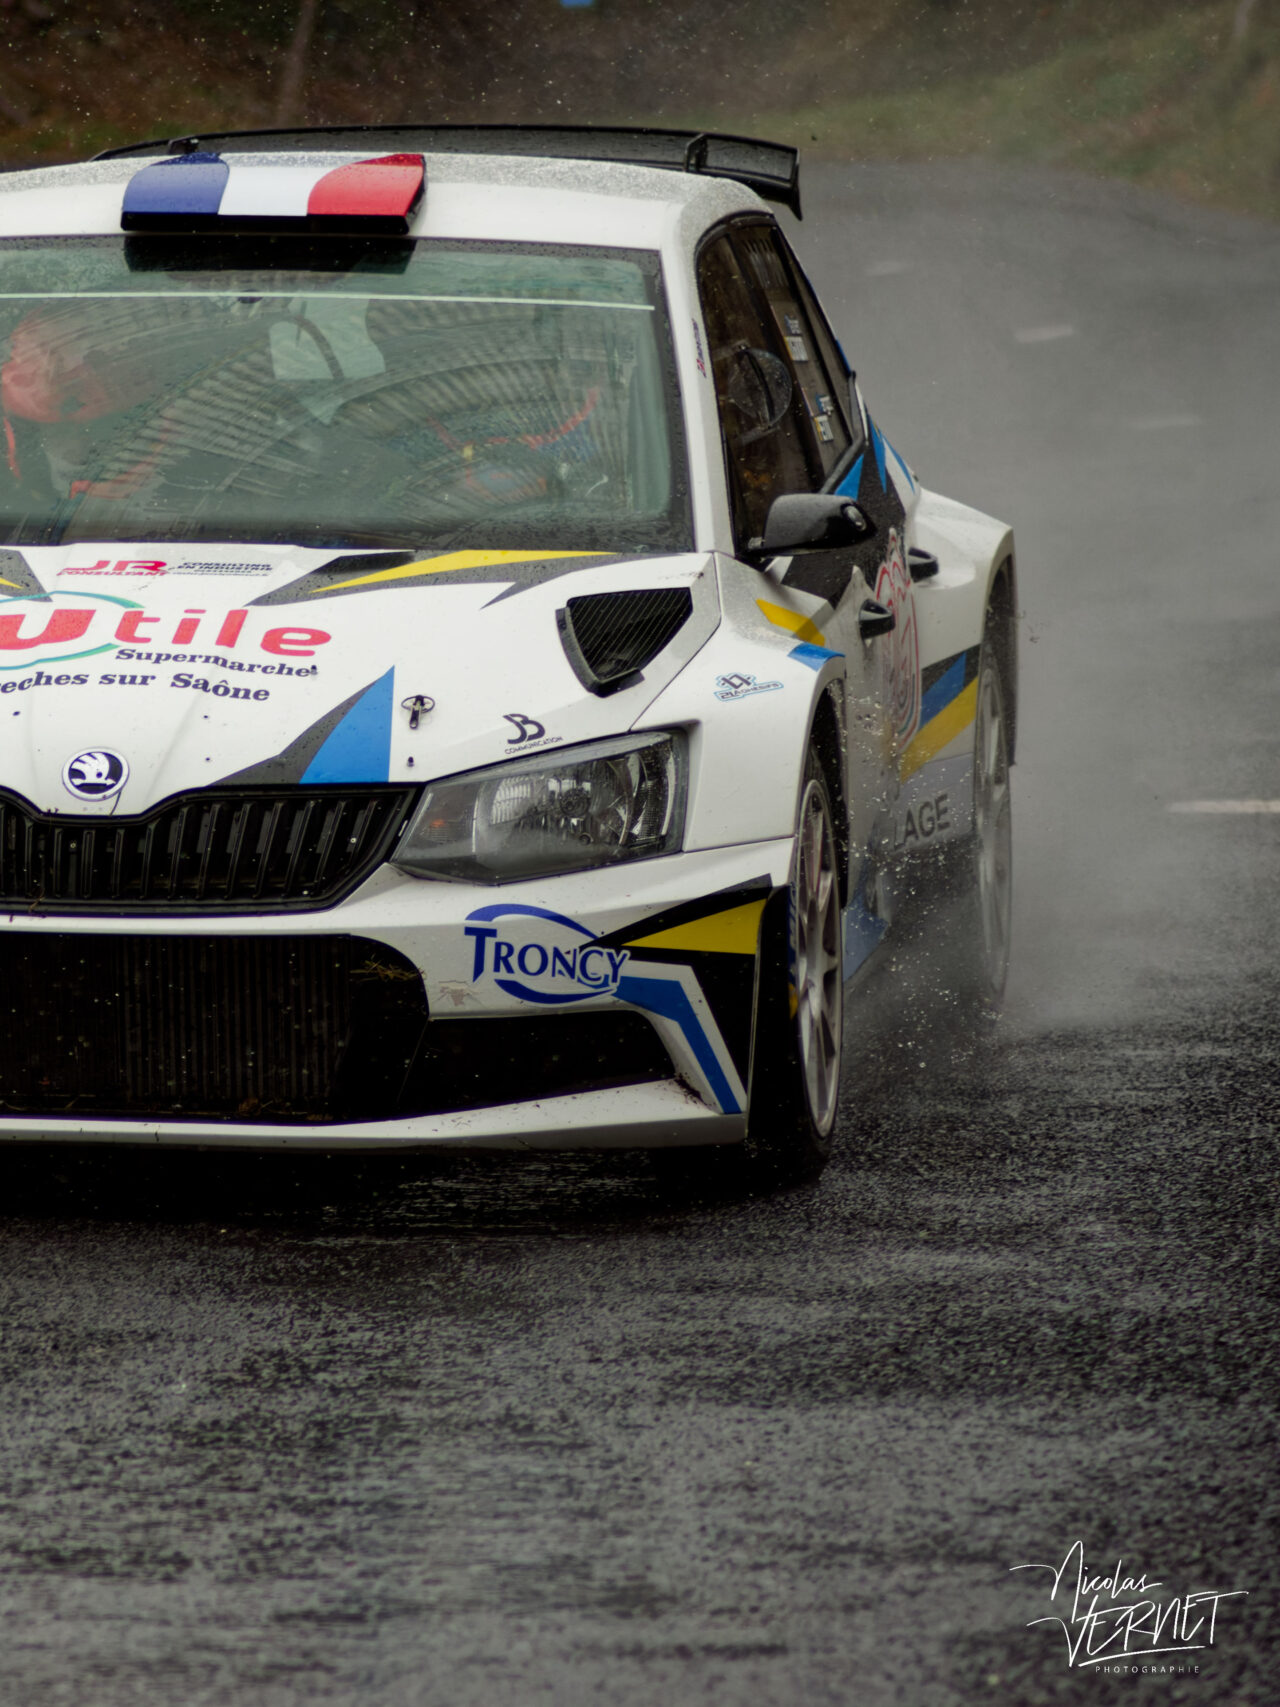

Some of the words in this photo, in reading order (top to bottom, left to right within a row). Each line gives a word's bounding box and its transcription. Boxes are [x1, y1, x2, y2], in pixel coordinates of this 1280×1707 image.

[64, 560, 167, 571] JR
[98, 672, 157, 687] sur
[170, 672, 271, 701] Saône
